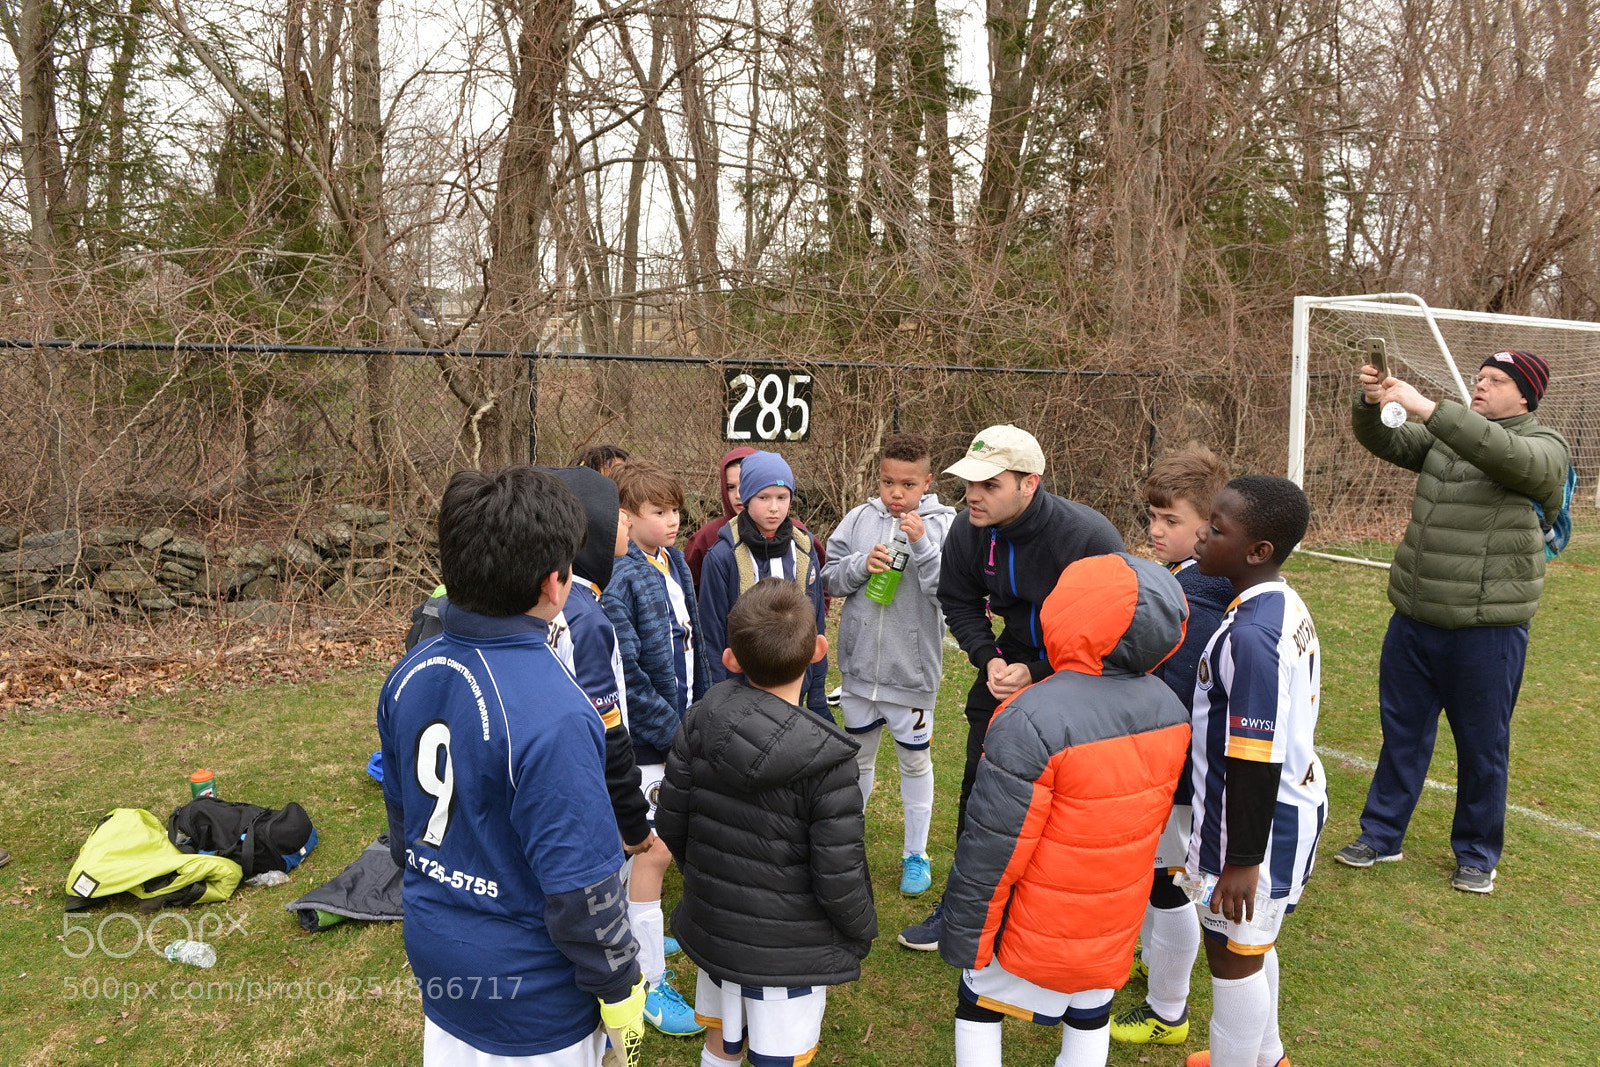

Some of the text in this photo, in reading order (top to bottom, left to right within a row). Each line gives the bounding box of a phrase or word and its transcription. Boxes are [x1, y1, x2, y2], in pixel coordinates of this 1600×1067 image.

[727, 373, 811, 440] 285
[447, 658, 483, 699] CONSTRUCTION
[476, 697, 490, 742] WORKERS
[911, 707, 926, 731] 2
[1249, 717, 1276, 731] WYSL
[414, 720, 455, 848] 9
[418, 856, 498, 898] 725-5755
